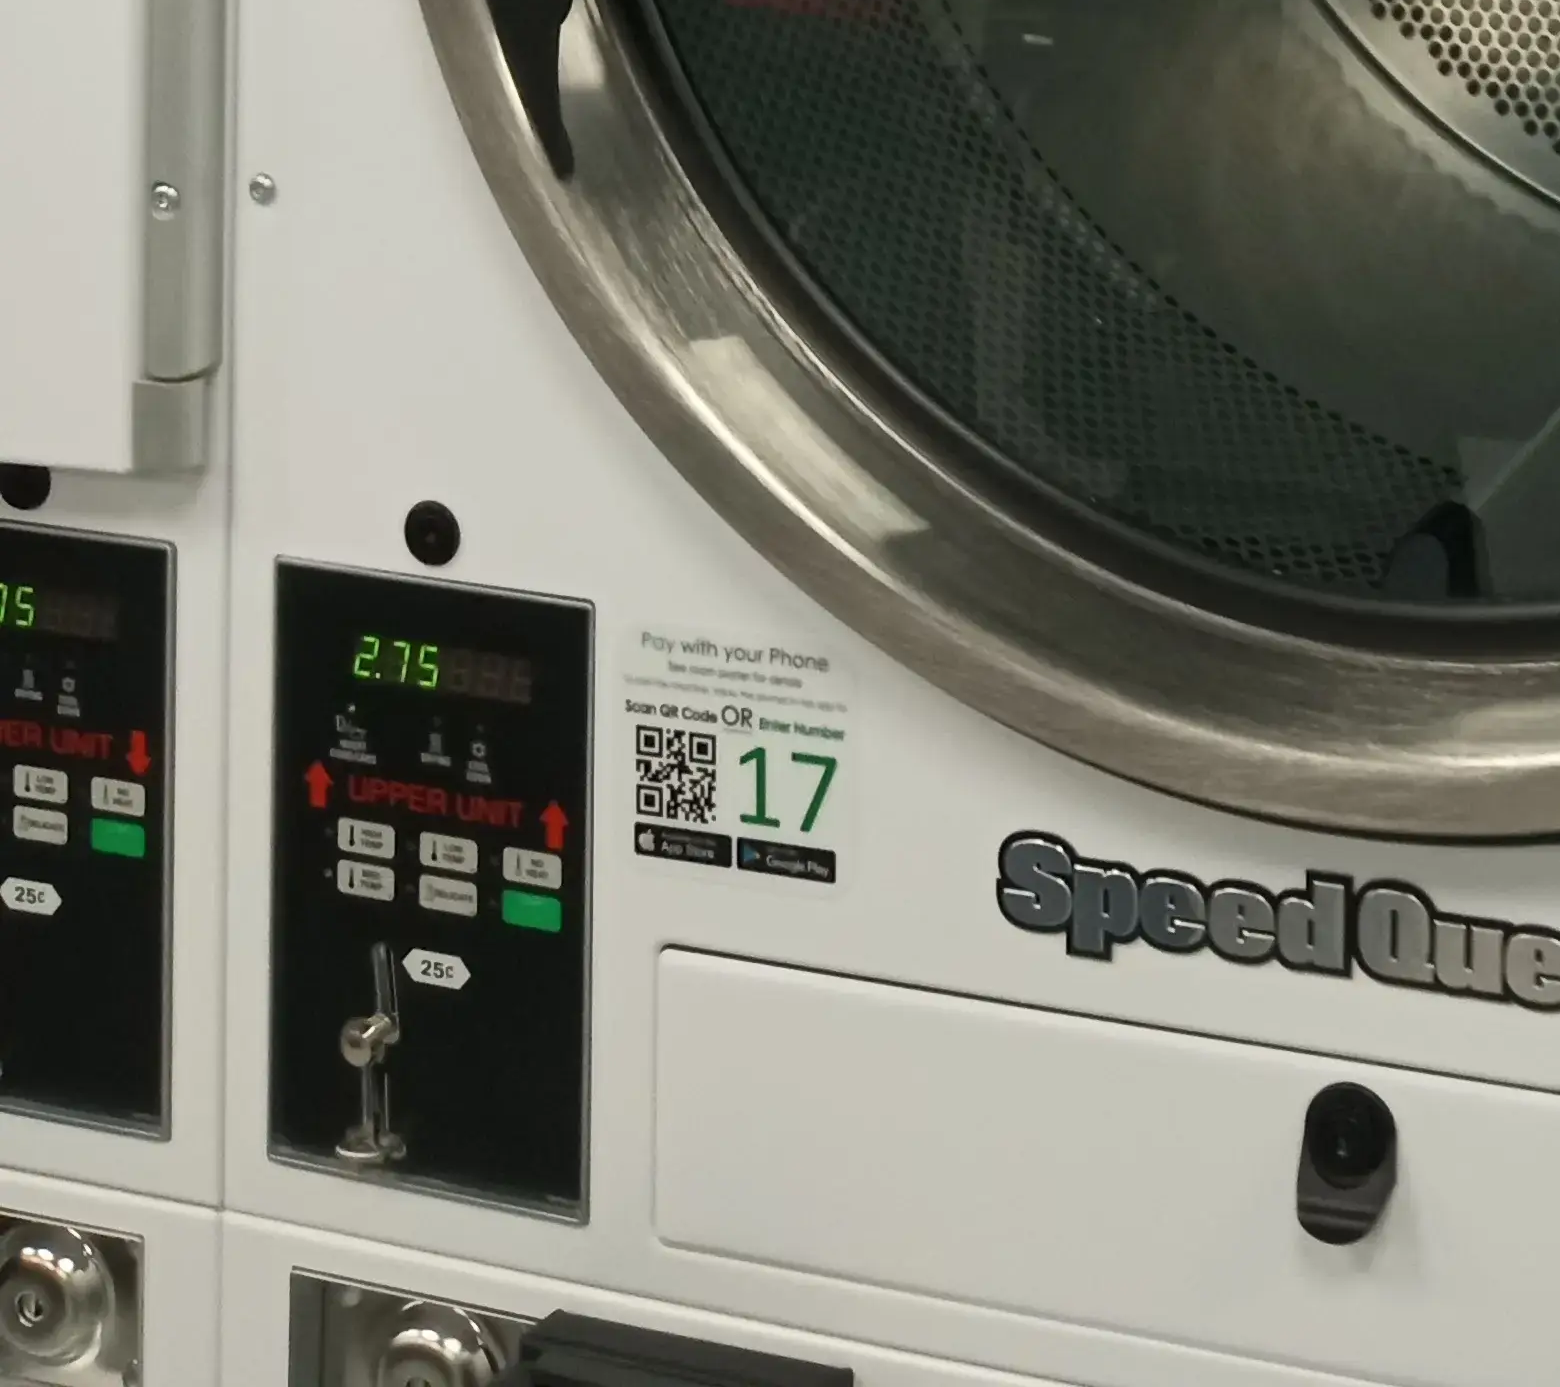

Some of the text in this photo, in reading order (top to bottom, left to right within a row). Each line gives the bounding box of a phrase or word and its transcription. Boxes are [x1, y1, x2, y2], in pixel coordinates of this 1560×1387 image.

[353, 635, 440, 689] 2.75
[641, 631, 831, 673] Pay with your Phone
[625, 698, 753, 728] Scan QR Code OR
[759, 717, 846, 741] Enter Number
[0, 718, 113, 759] ER UNIT
[350, 773, 524, 828] UPPER UNIT
[738, 745, 838, 833] 17
[660, 841, 684, 857] App
